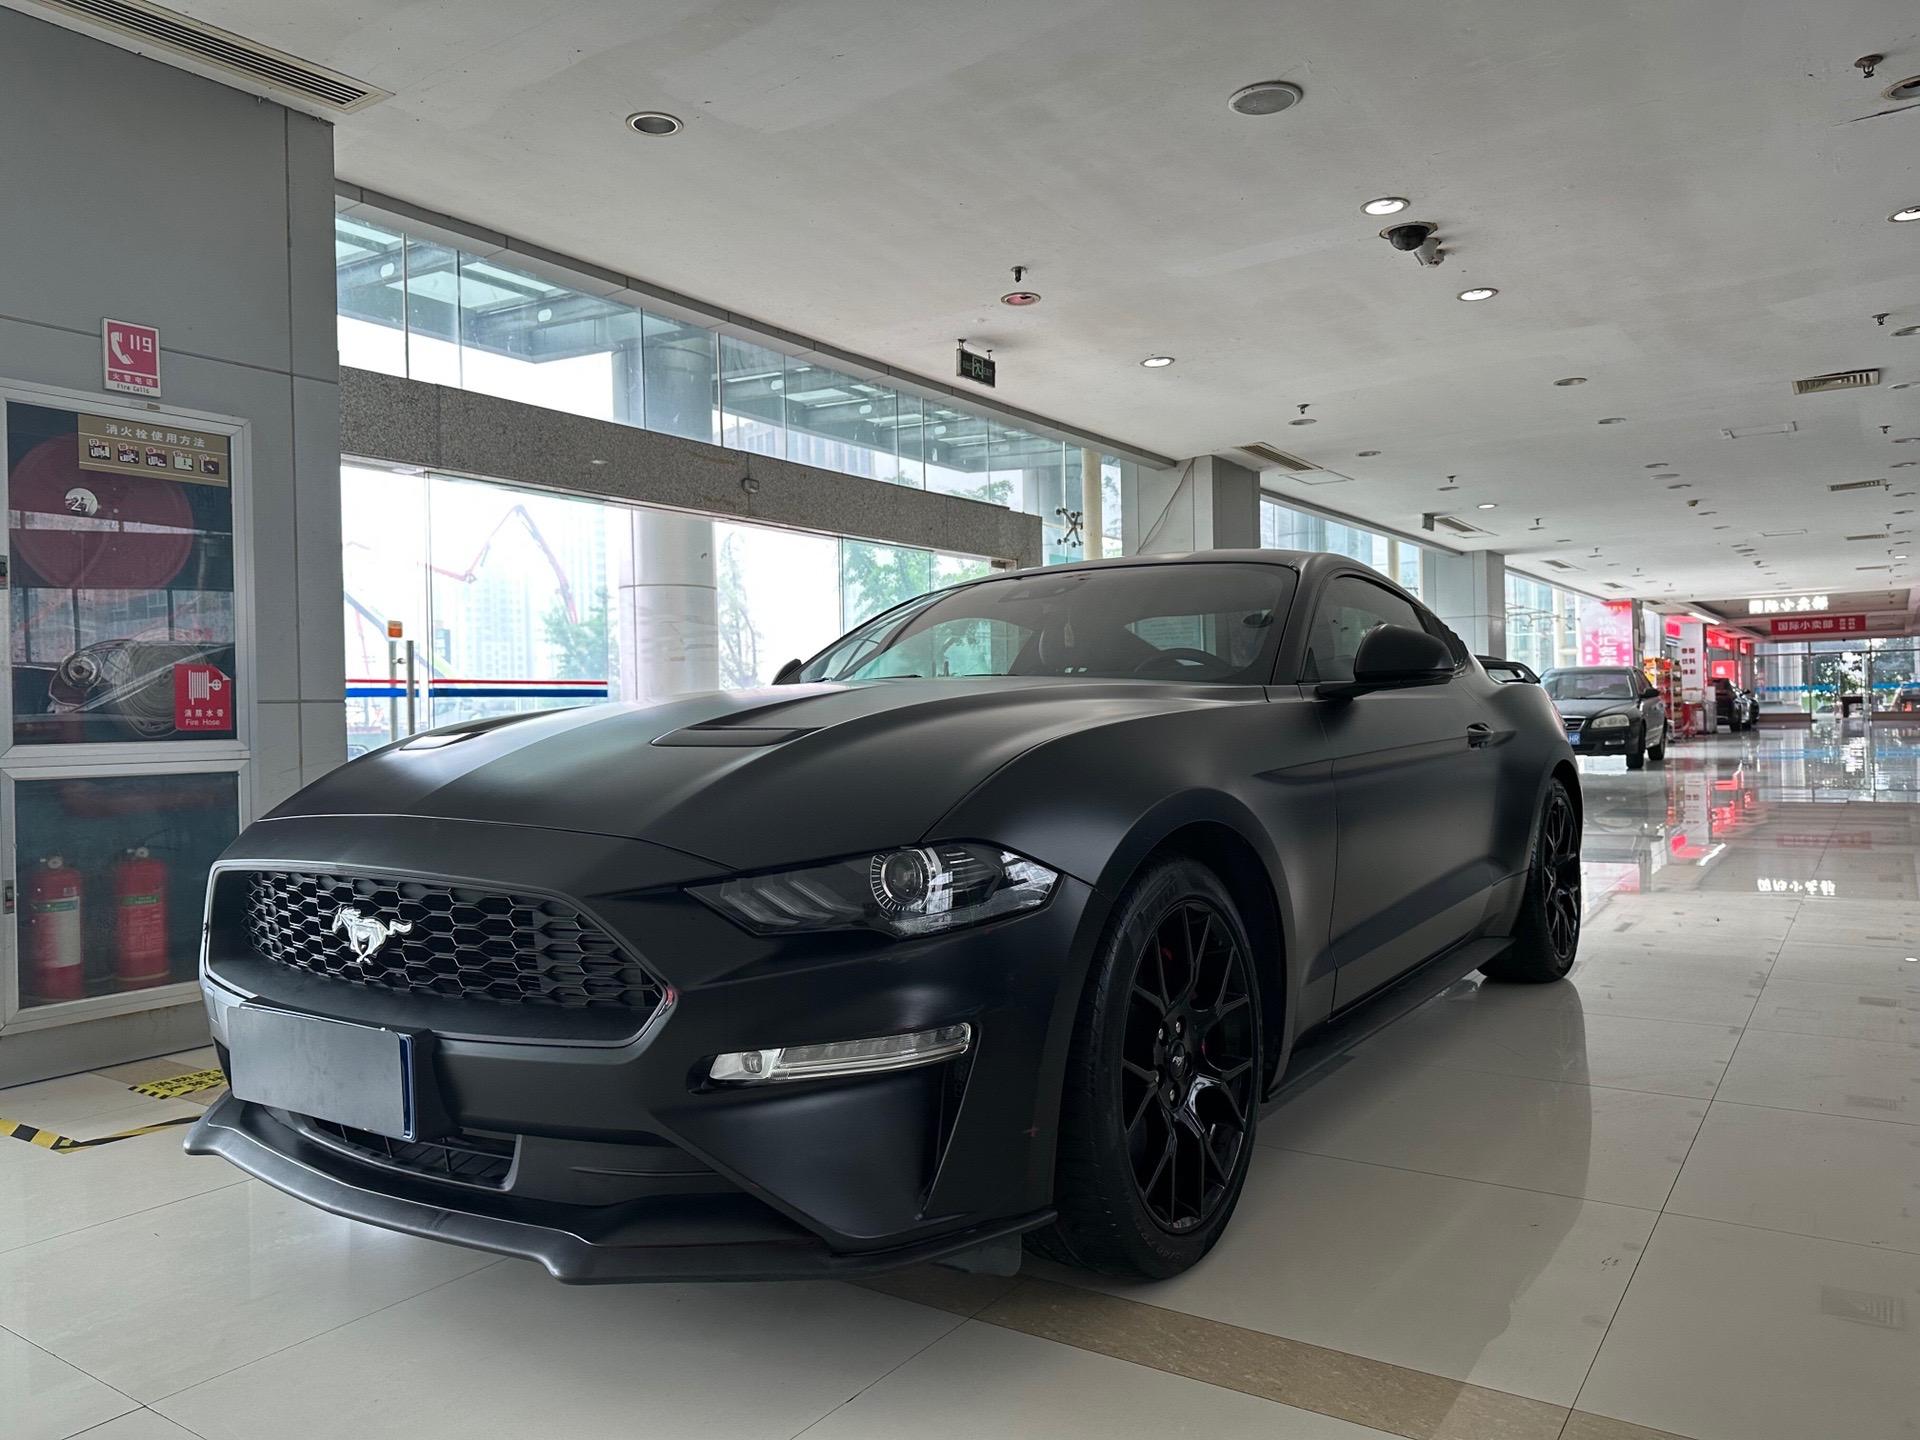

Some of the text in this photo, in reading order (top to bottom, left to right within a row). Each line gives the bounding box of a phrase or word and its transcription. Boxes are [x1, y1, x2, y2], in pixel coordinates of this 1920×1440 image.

[130, 334, 152, 353] 119
[106, 423, 205, 447] 消火栓使用方法
[1777, 620, 1834, 632] 国际小卖部
[185, 718, 220, 726] Fire Hose
